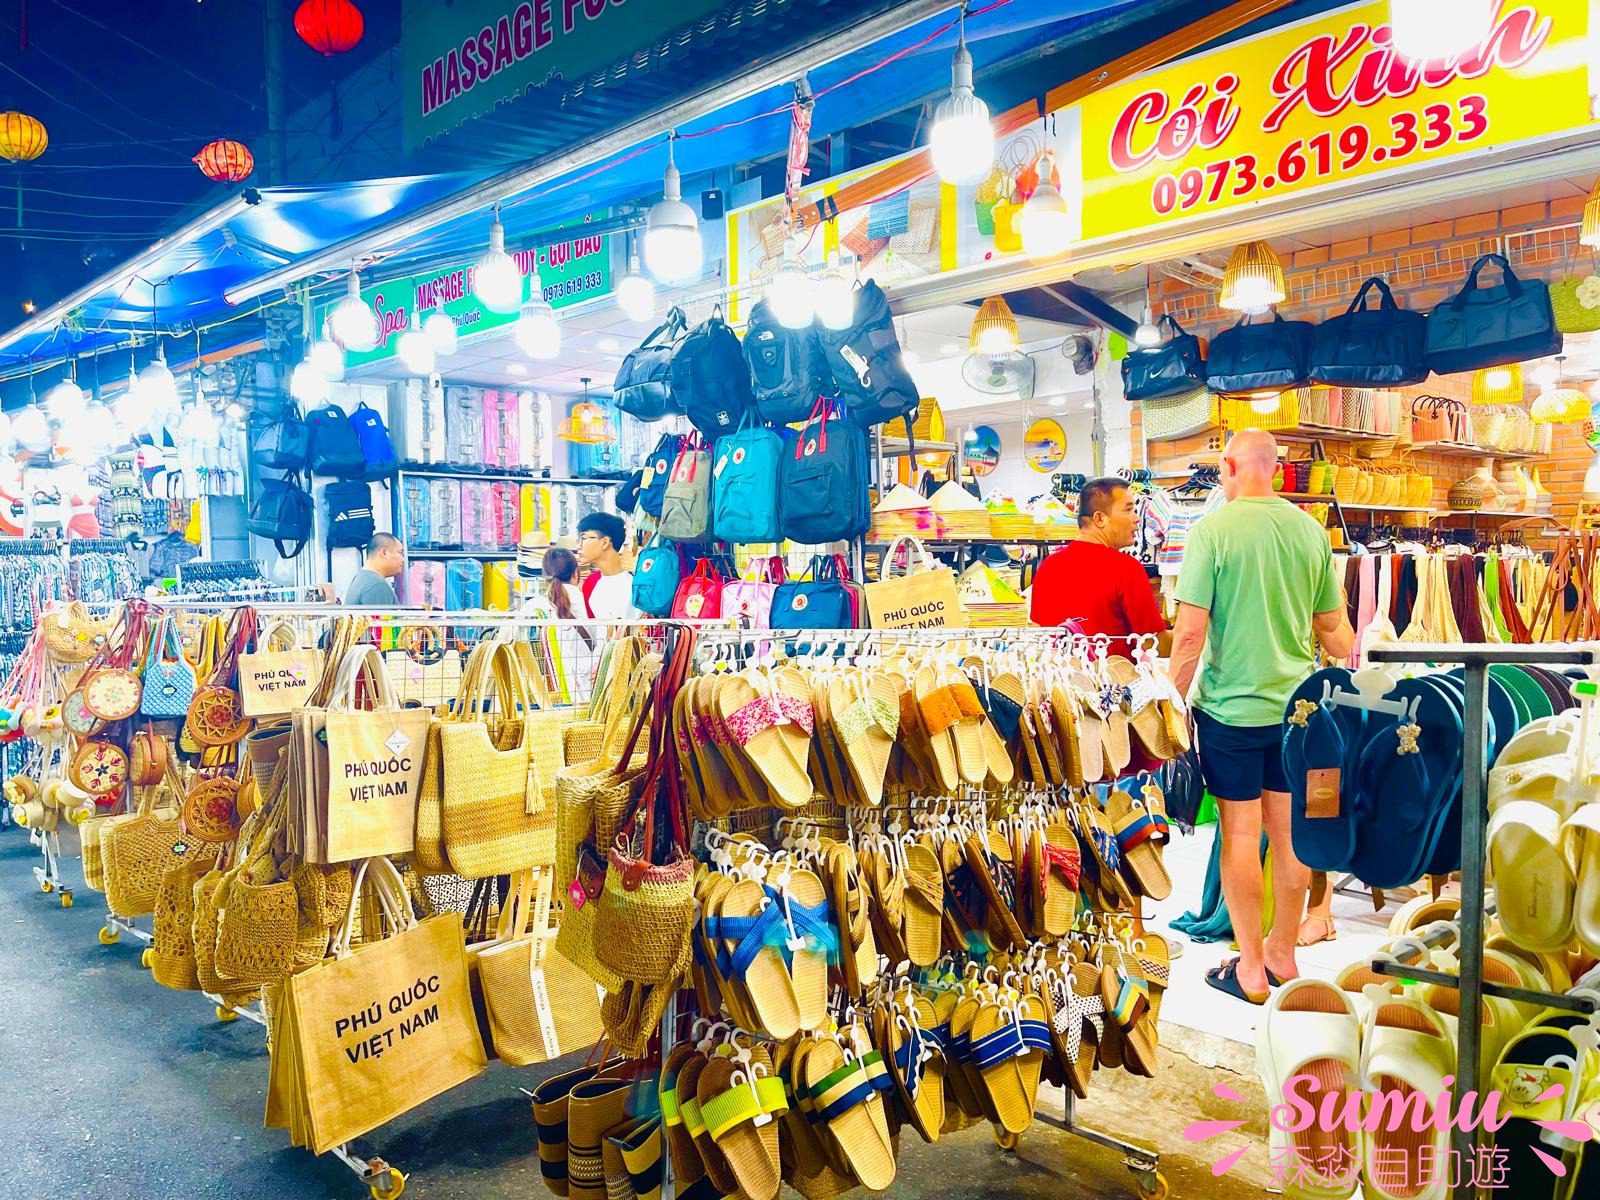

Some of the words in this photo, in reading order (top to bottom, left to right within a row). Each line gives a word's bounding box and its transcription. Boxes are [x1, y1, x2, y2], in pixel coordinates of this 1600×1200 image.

[421, 0, 553, 117] MASSAGE
[1110, 73, 1241, 173] Cói
[1152, 95, 1489, 215] 0973.619.333
[513, 249, 536, 276] ODY
[543, 284, 564, 303] 0973
[566, 279, 583, 295] 619
[584, 271, 602, 290] 333
[374, 293, 409, 348] Spa
[883, 607, 907, 622] PHÚ
[919, 616, 945, 630] NAM
[254, 669, 275, 680] PHÚ
[284, 679, 306, 688] NAM
[344, 759, 369, 778] PHÚ
[370, 756, 412, 776] QUỐC
[349, 784, 375, 803] VIỆT
[377, 780, 408, 798] NAM
[335, 1001, 382, 1038] PHÚ
[388, 975, 440, 1015] QUỐC
[345, 1028, 394, 1064] VIỆT
[399, 1004, 440, 1040] NAM
